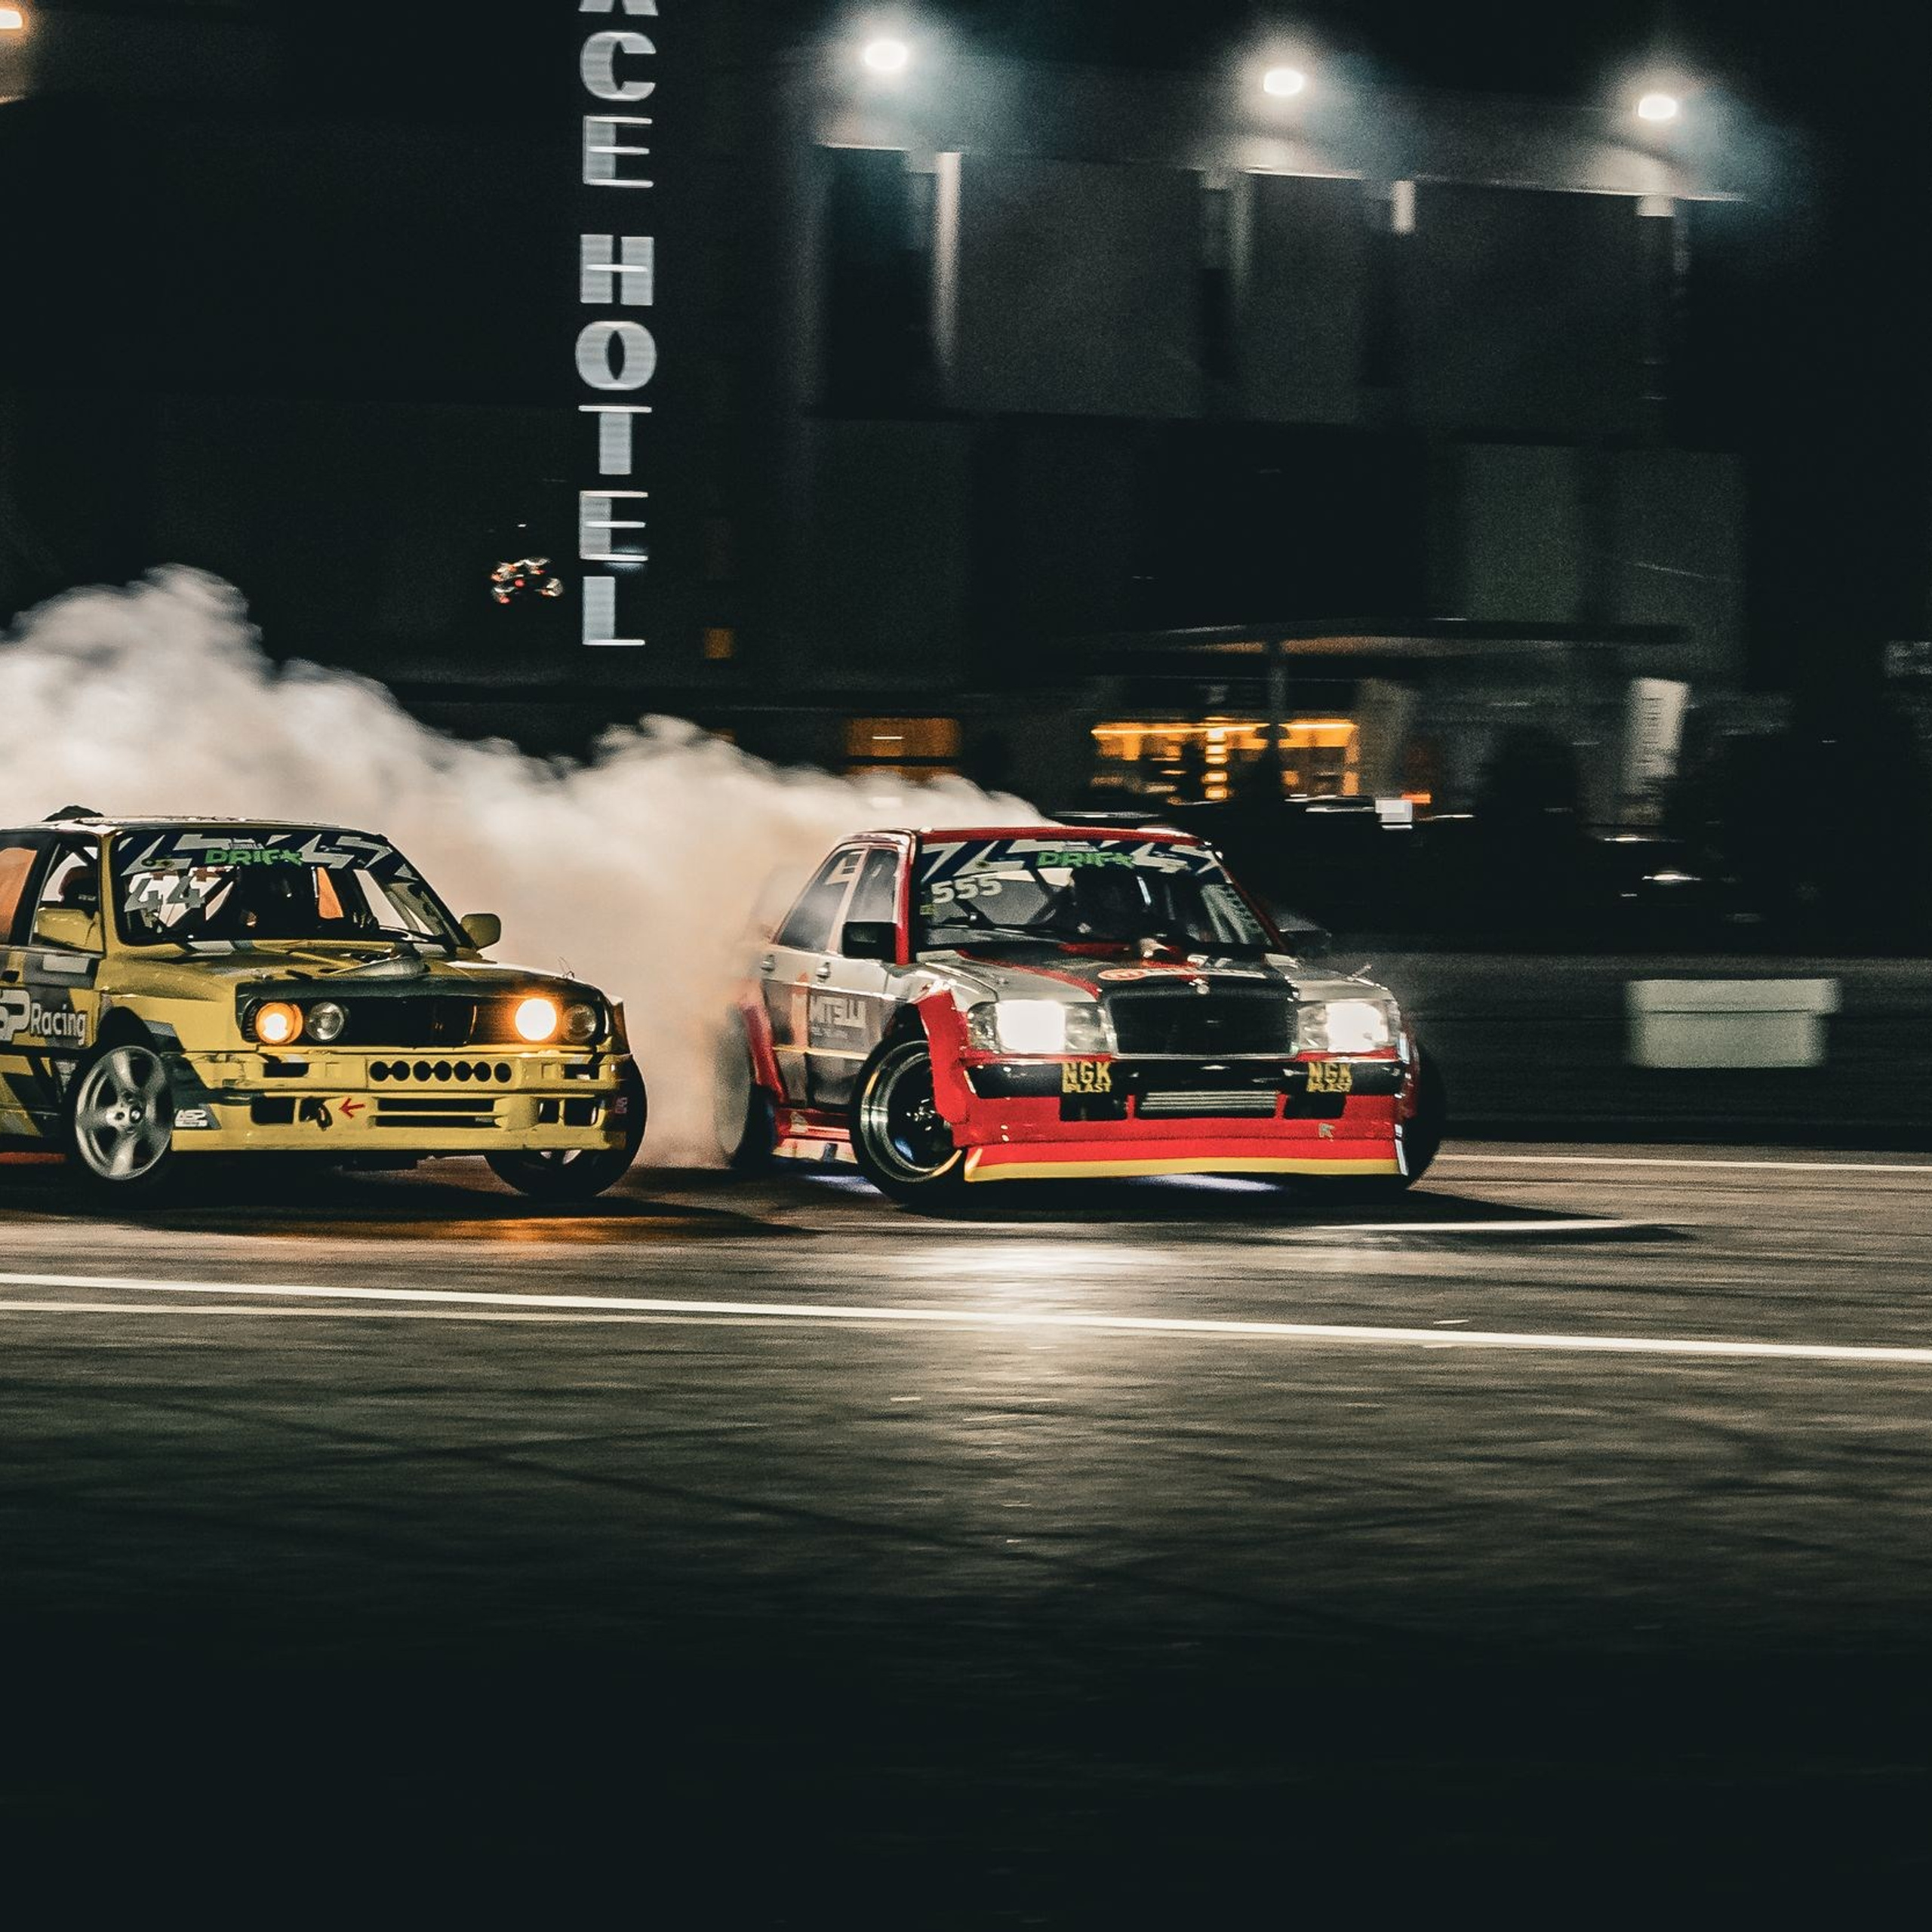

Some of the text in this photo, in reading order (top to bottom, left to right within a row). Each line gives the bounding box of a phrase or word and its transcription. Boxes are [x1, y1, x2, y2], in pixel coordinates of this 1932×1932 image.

[575, 0, 658, 647] CE HOTEL
[124, 875, 206, 912] 44
[931, 875, 1002, 904] 555
[31, 1002, 87, 1046] Racing
[1062, 1061, 1112, 1084] NGK
[1308, 1061, 1352, 1084] NGK
